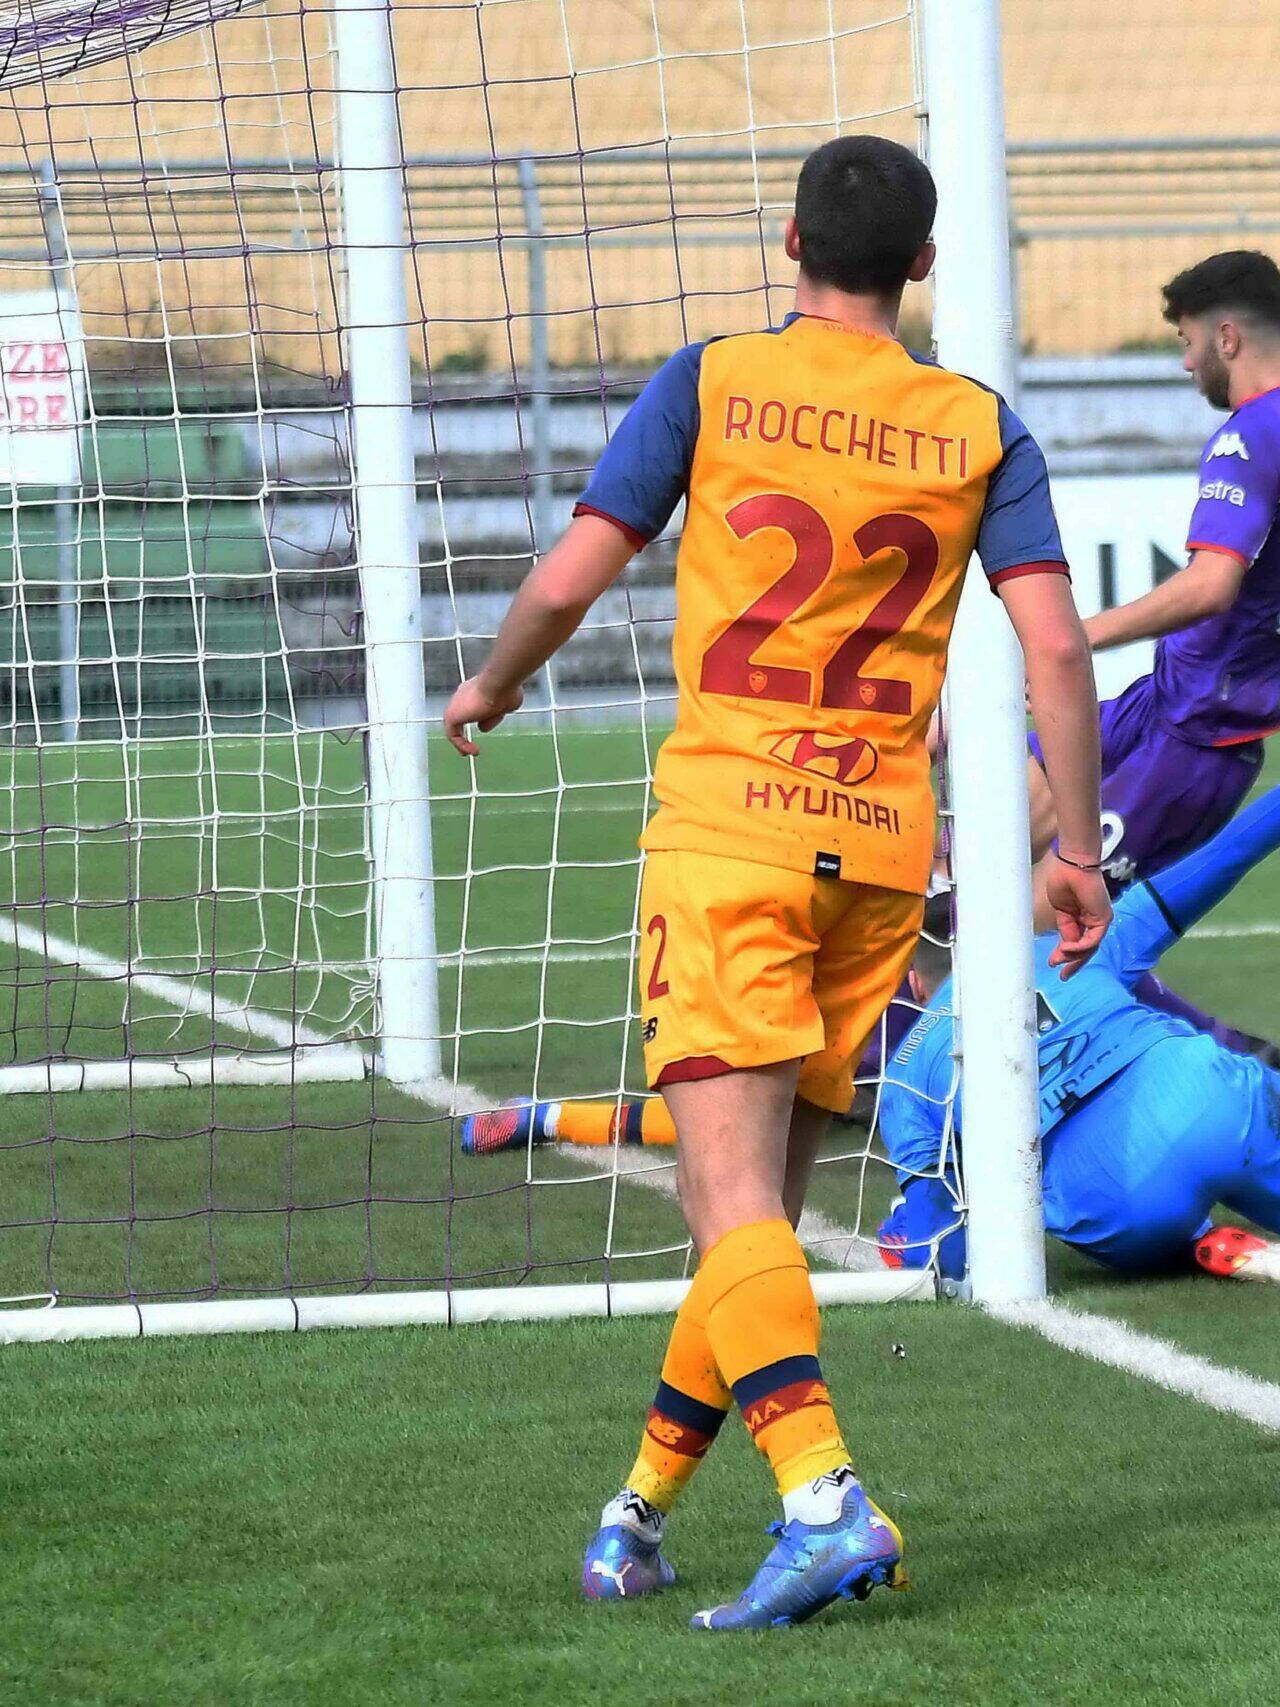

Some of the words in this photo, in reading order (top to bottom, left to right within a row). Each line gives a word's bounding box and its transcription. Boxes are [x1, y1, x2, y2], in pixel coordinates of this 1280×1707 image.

[724, 395, 969, 479] ROCCHETTI
[1198, 480, 1245, 507] stra
[700, 493, 940, 716] 22
[745, 781, 902, 836] HYUNDAI
[647, 914, 670, 1001] 2
